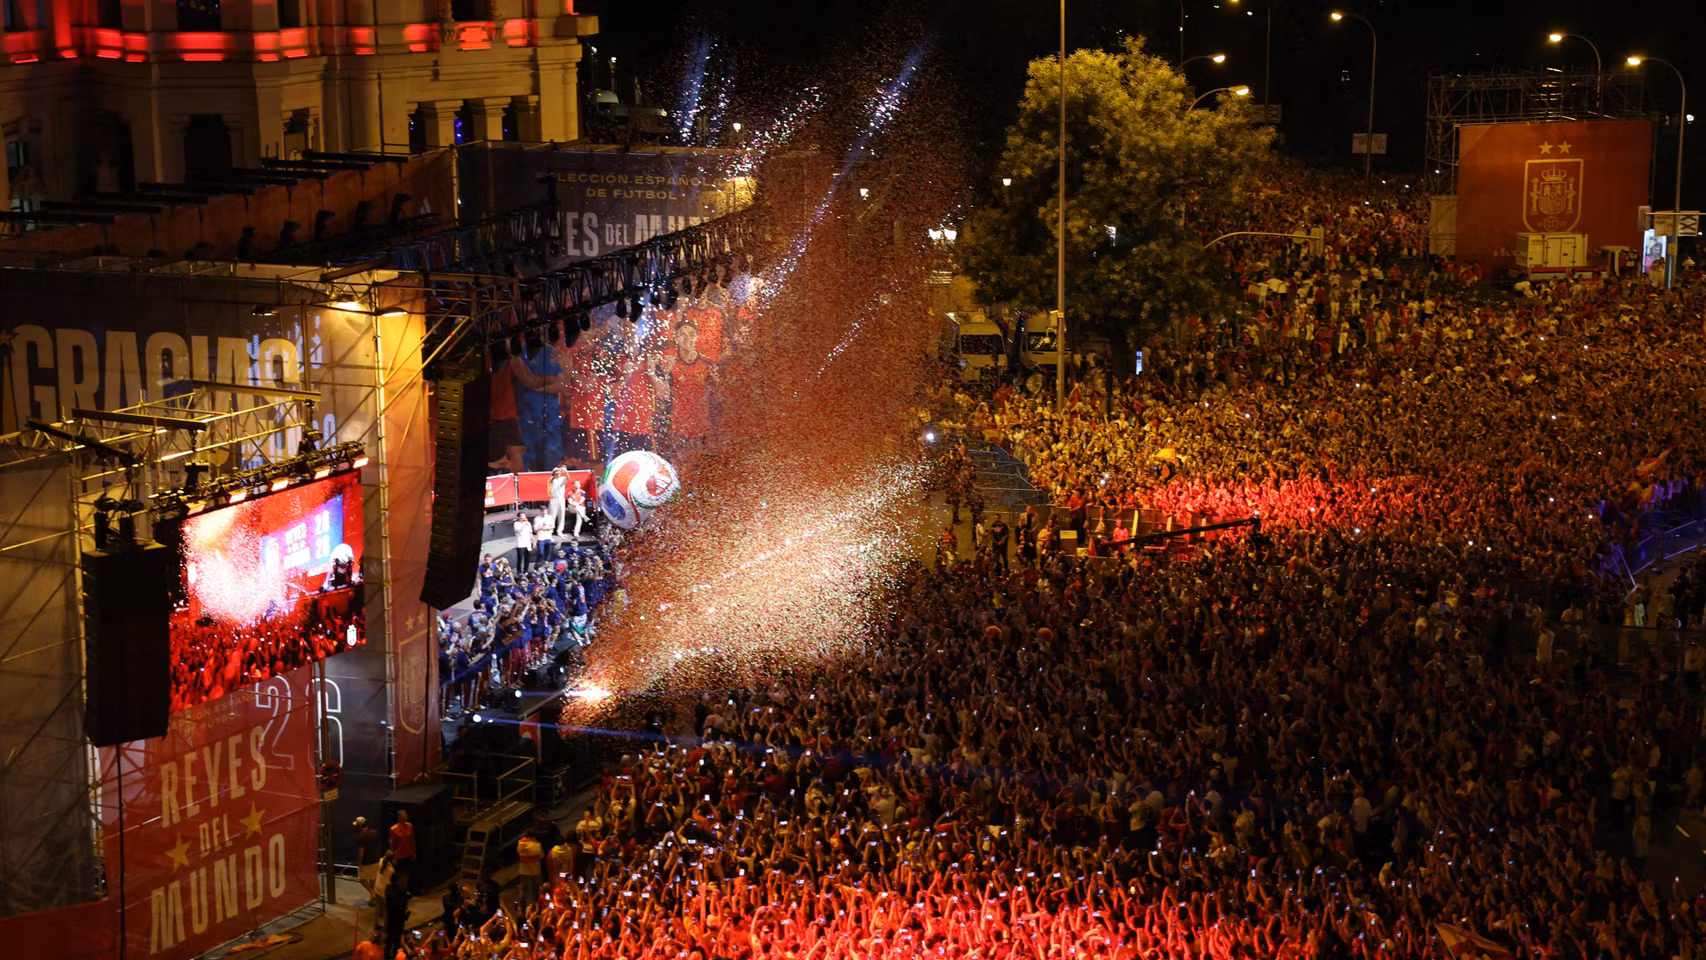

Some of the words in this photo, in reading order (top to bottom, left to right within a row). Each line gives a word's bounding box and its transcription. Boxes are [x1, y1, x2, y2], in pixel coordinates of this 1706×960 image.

[585, 187, 607, 198] DE
[566, 211, 599, 258] ES
[605, 222, 631, 246] DEL
[255, 674, 344, 774] 26
[160, 725, 267, 829] REYES
[198, 813, 233, 858] DEL
[150, 832, 286, 955] MUNDO
